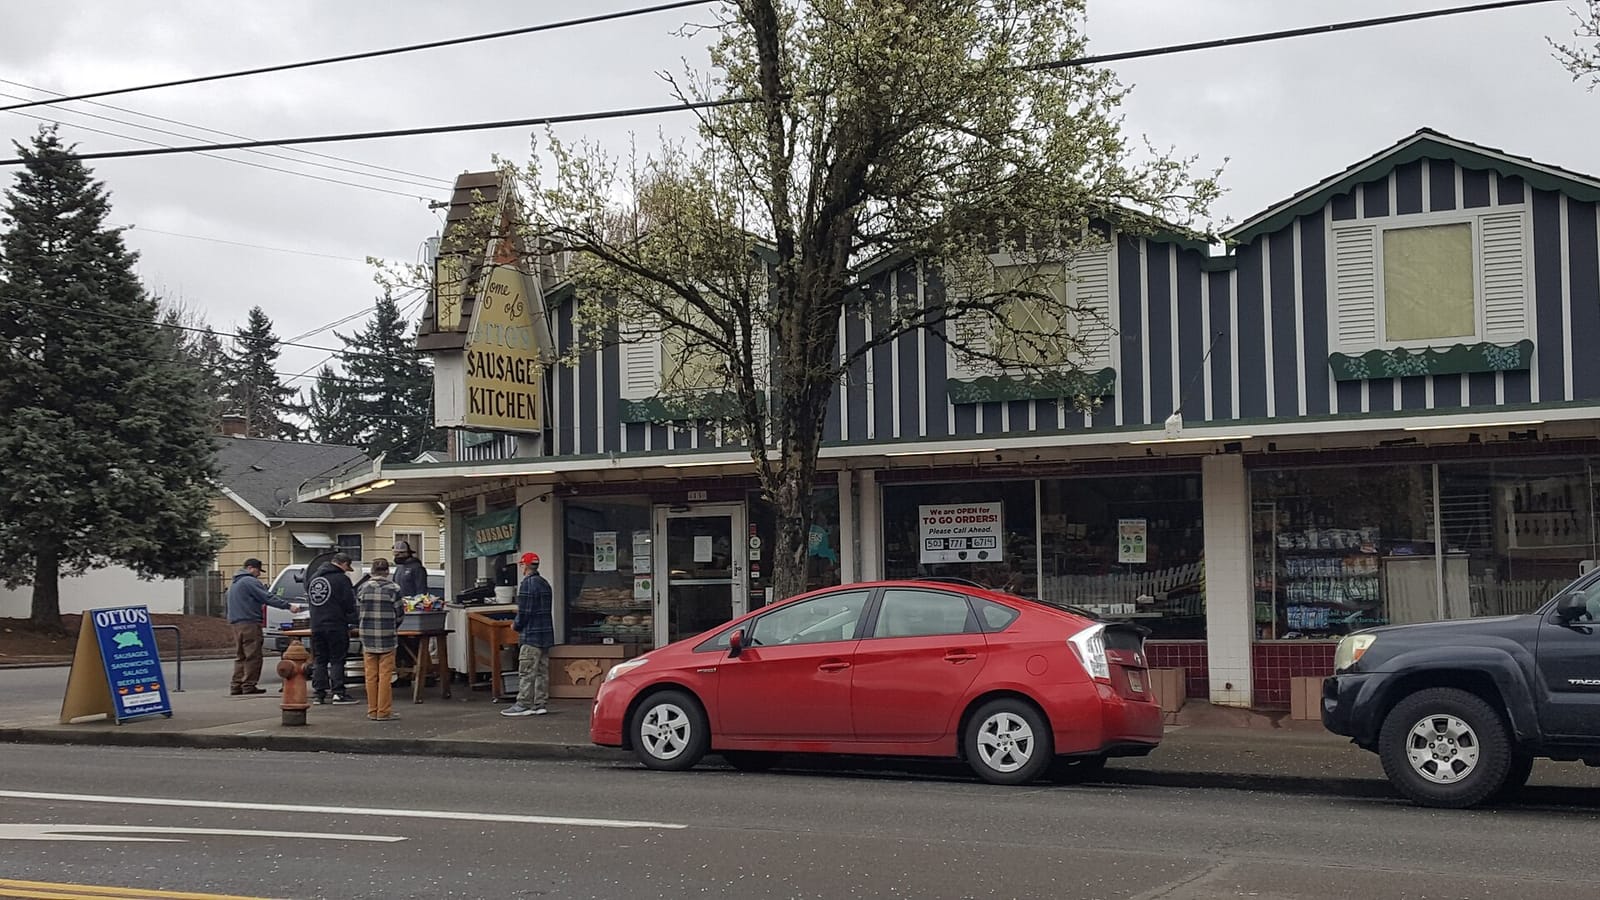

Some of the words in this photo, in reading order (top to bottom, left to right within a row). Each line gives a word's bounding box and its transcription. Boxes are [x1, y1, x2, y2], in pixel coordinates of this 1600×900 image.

[504, 293, 524, 321] of
[467, 350, 535, 385] SAUSAGE
[469, 386, 536, 420] KITCHEN
[922, 516, 937, 525] TO
[938, 516, 953, 524] GO
[955, 514, 998, 524] ORDERS!
[928, 527, 952, 535] Please
[967, 526, 993, 534] Ahead.
[96, 608, 148, 628] OTTO'S
